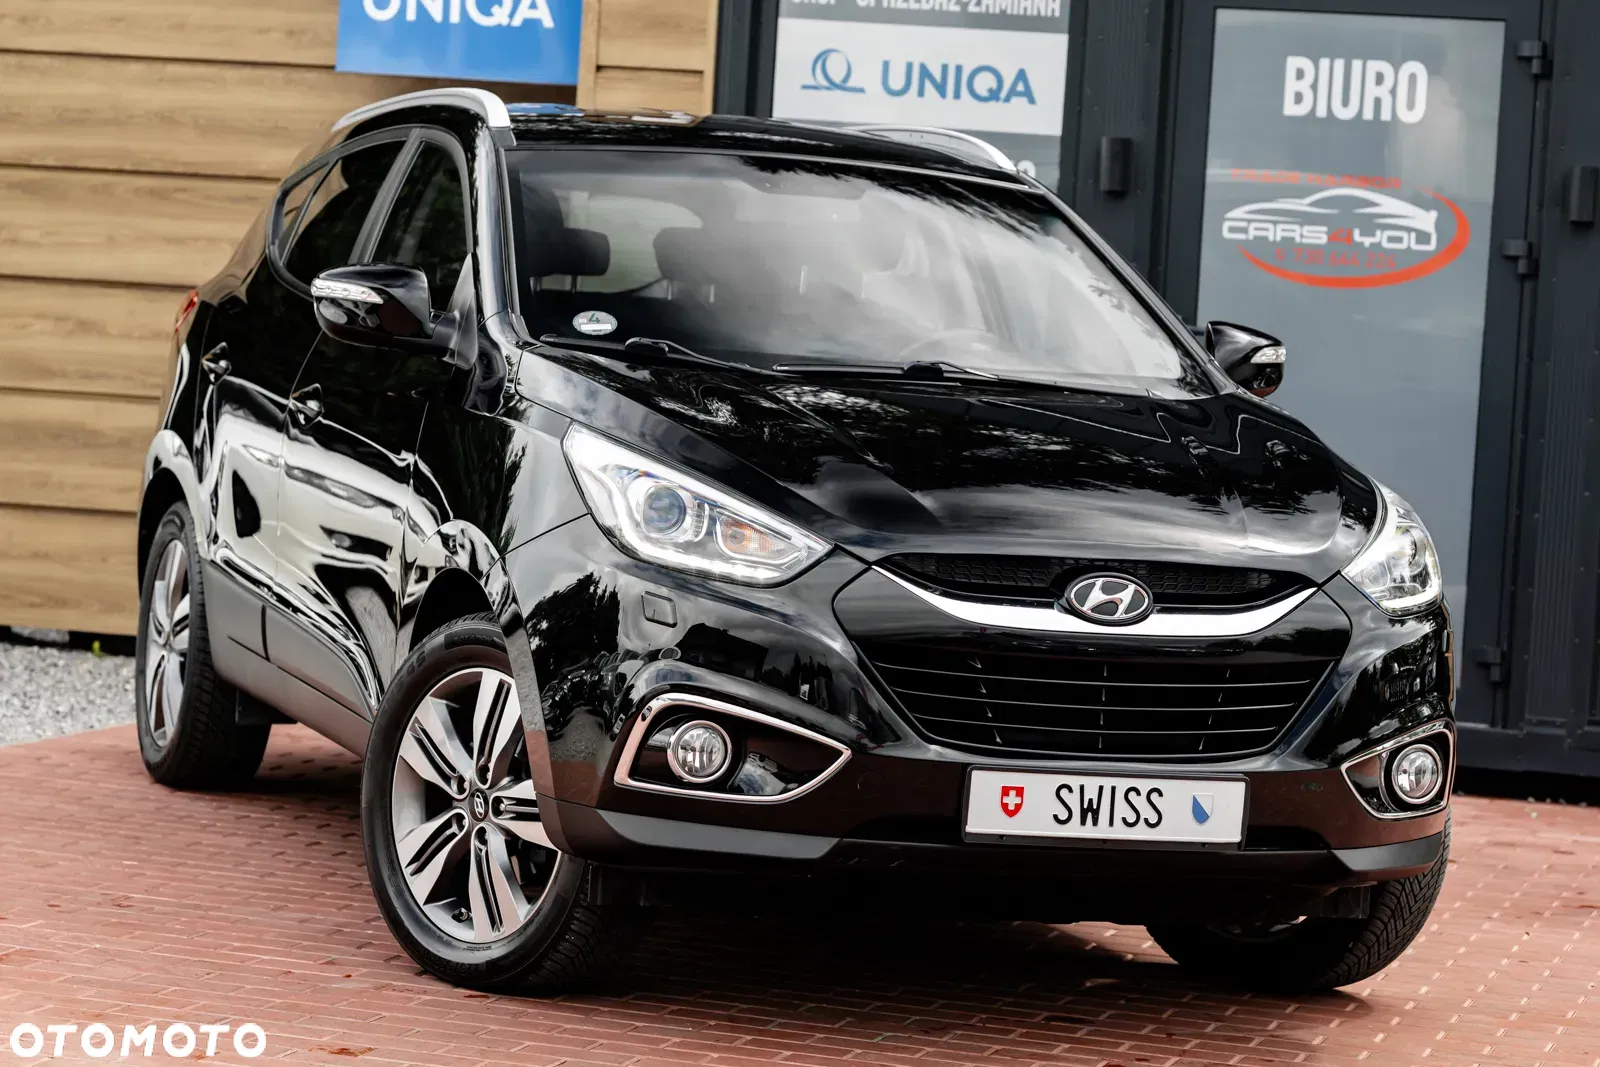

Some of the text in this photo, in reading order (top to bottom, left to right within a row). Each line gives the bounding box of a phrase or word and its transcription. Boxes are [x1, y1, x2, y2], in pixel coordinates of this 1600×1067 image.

[880, 59, 1037, 105] UNIQA
[1282, 55, 1429, 125] BIURO
[1222, 219, 1438, 251] CARS4YOU
[1052, 783, 1164, 829] SWISS
